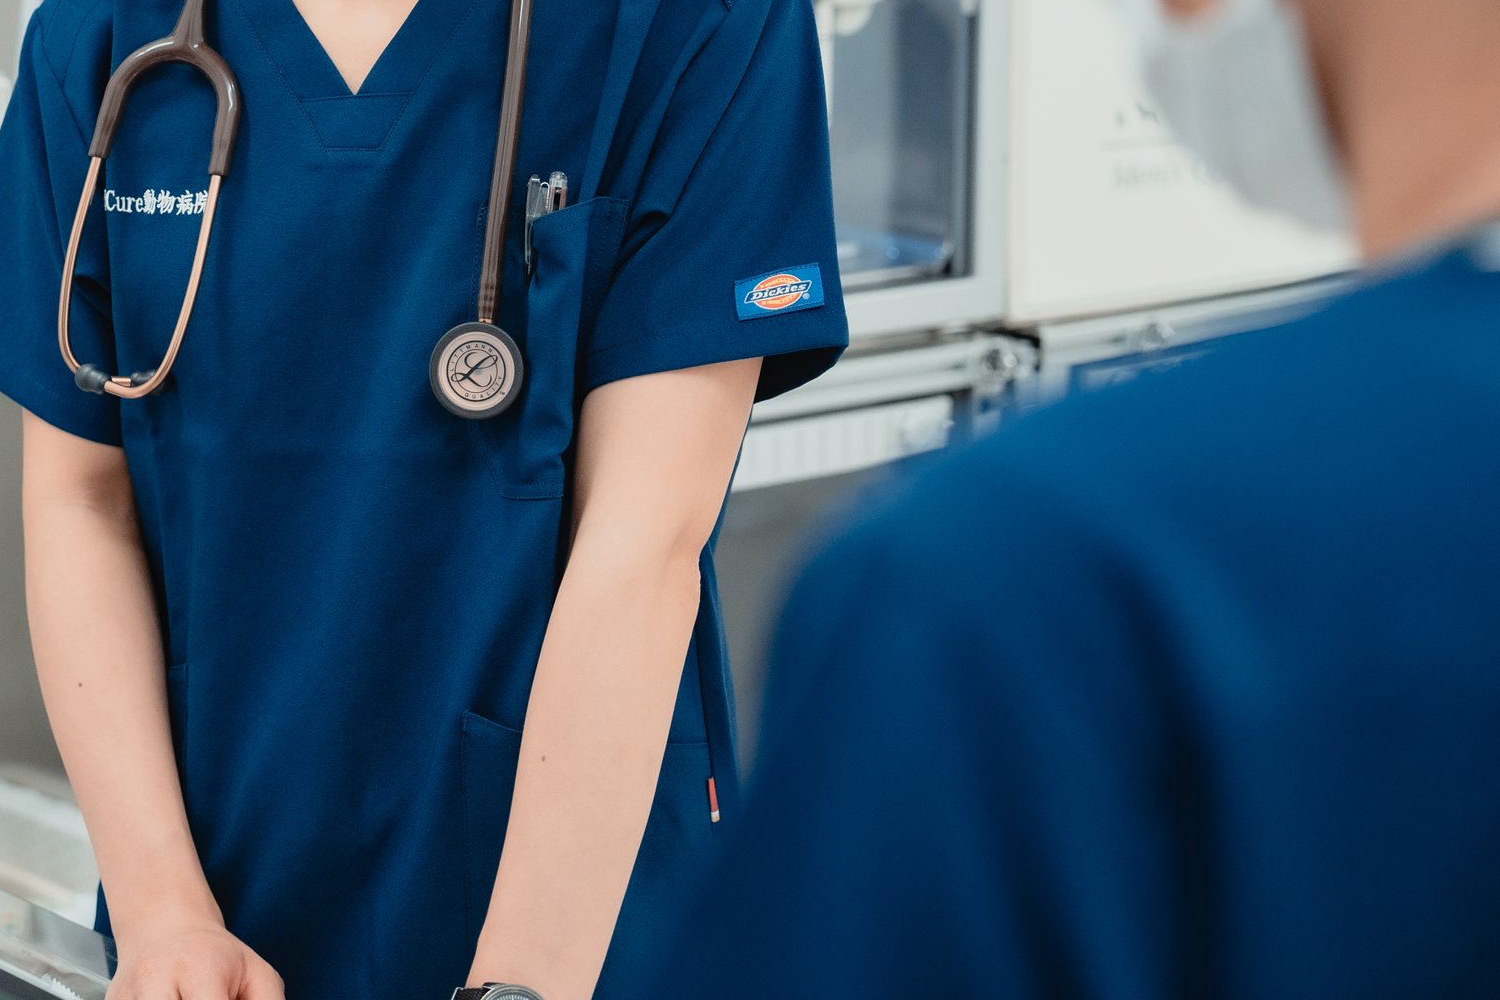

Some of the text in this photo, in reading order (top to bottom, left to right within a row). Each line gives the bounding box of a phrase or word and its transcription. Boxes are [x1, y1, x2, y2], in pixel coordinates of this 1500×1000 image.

[104, 189, 209, 215] Cure動物病院
[750, 283, 807, 300] Dickies
[450, 344, 493, 371] LITTMANN
[464, 376, 502, 399] QUALITY
